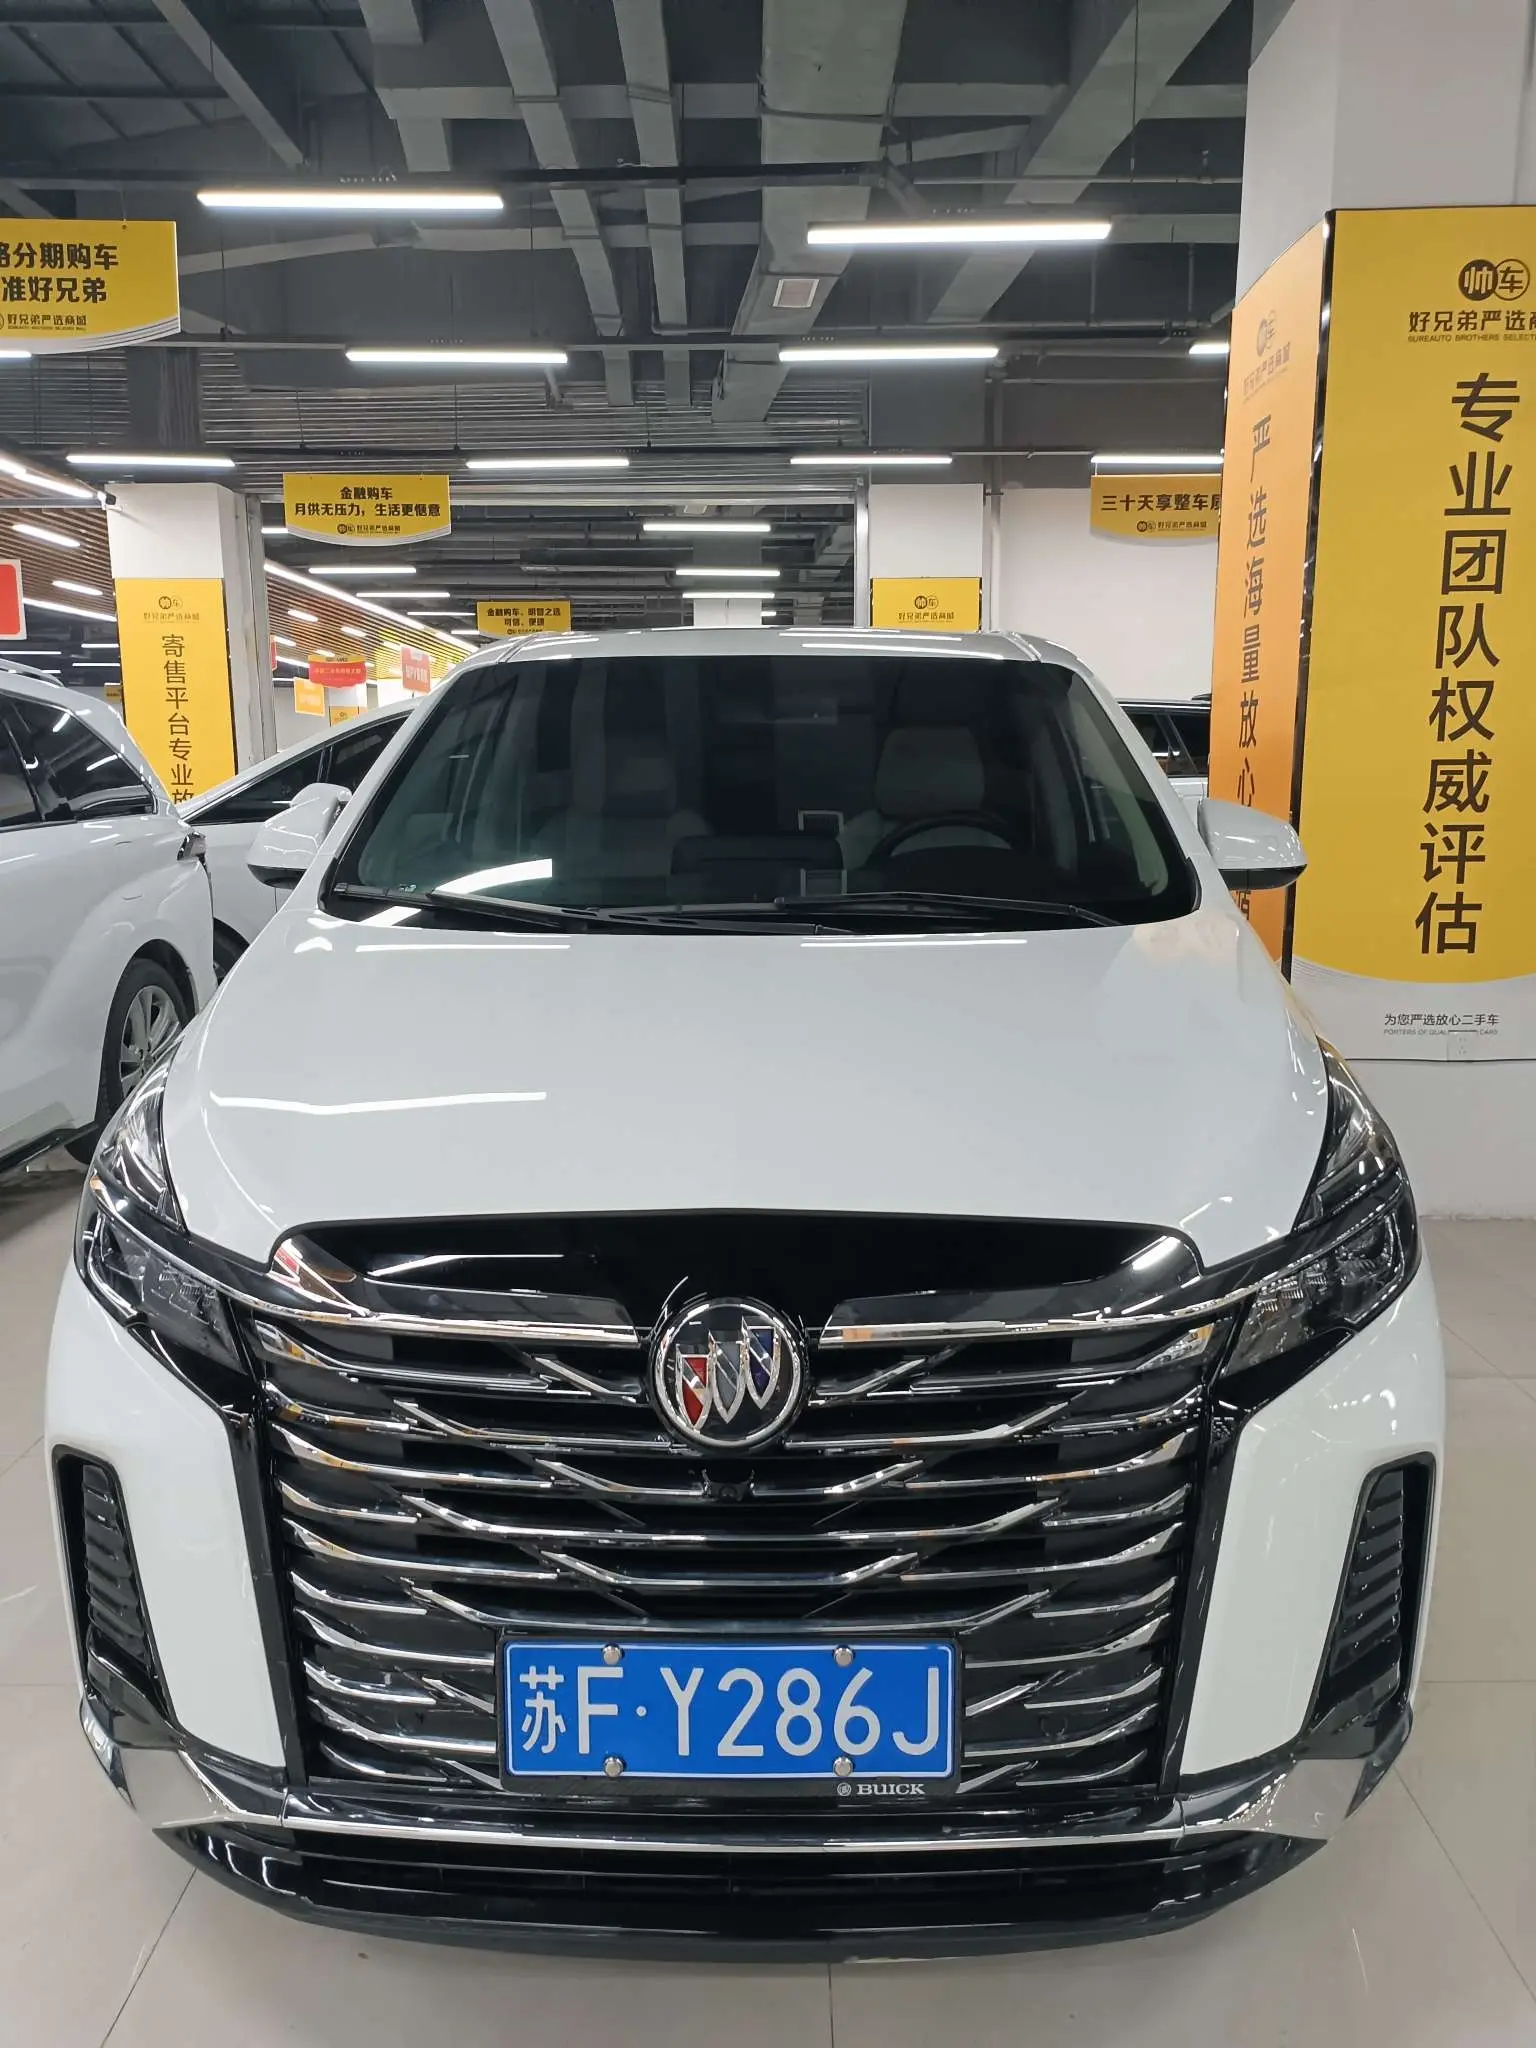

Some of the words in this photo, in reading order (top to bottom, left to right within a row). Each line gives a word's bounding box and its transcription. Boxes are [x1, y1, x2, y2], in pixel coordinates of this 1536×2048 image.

[1, 275, 107, 304] 准好兄弟
[340, 487, 393, 500] 金融购车
[1414, 372, 1521, 955] 专业团队权威评估
[1384, 1013, 1500, 1026] 为您严选放心二手车
[855, 1783, 927, 1796] BUICK
